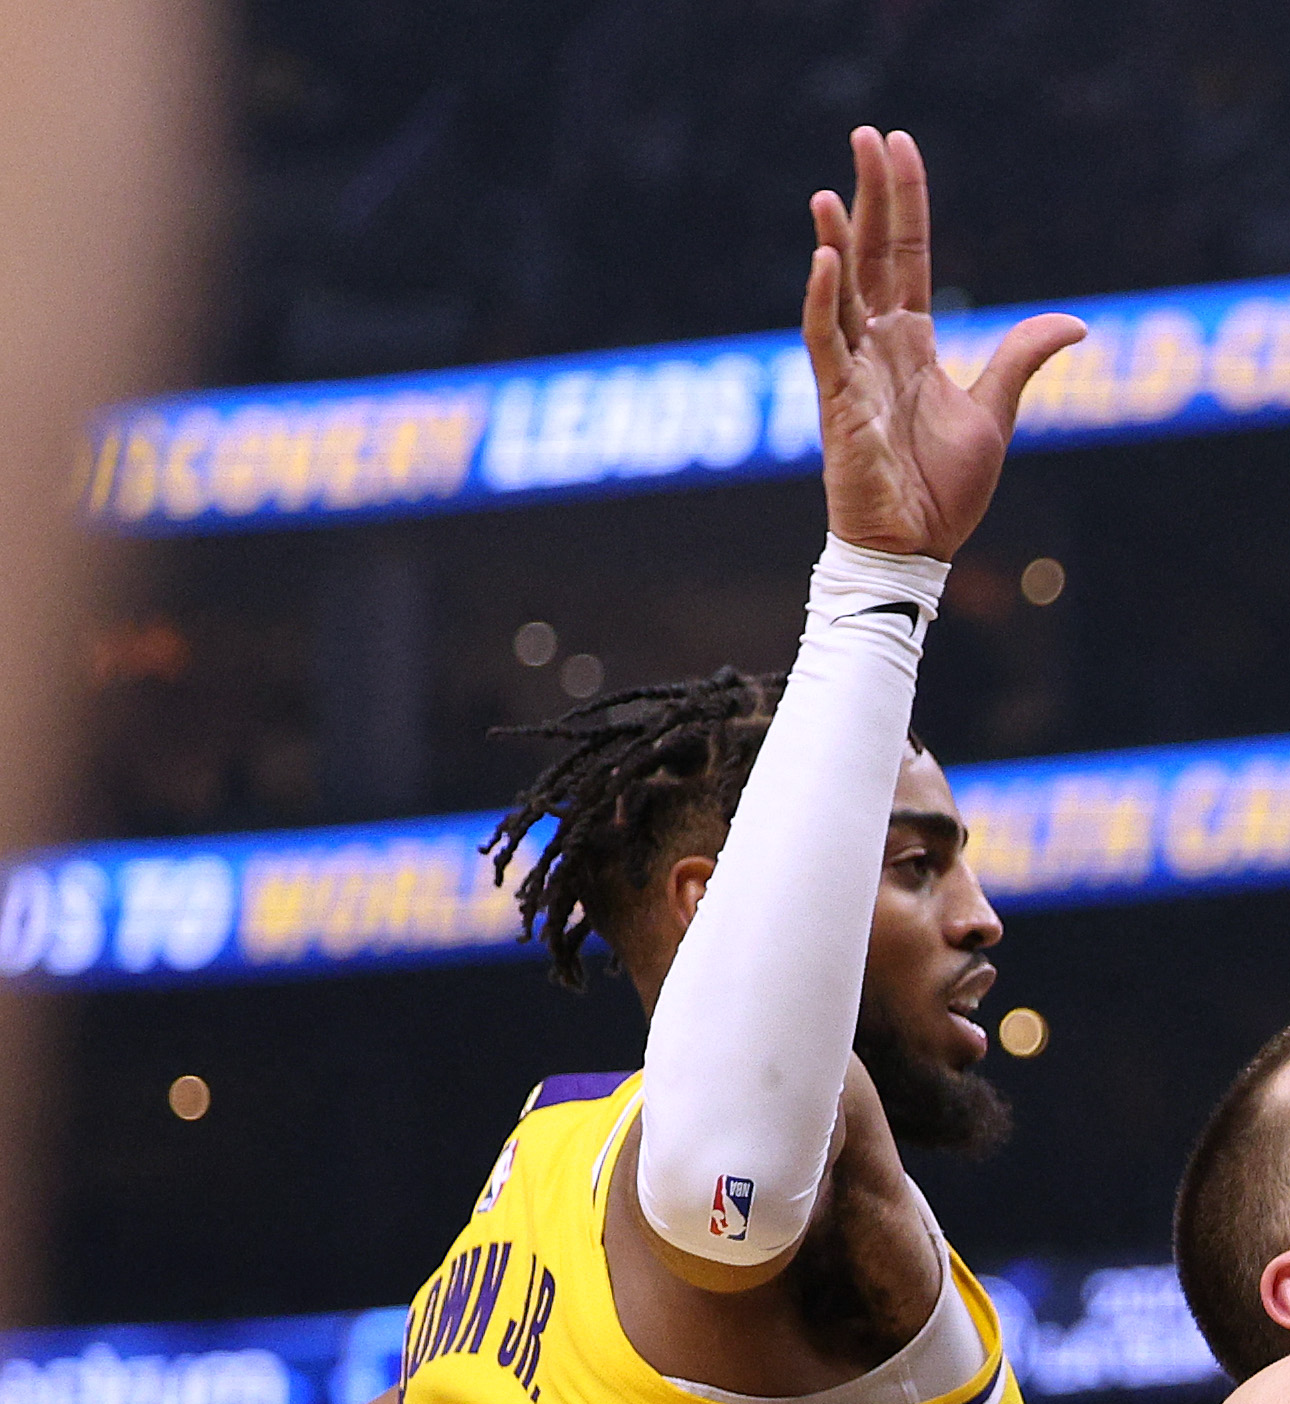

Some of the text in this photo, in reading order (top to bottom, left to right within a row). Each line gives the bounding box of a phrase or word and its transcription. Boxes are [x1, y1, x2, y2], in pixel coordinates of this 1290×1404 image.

[74, 384, 488, 522] ISCOVERY
[482, 350, 770, 496] LEADS
[953, 766, 1162, 896] ALTH
[113, 856, 233, 975] TO
[729, 1180, 751, 1198] NBA
[400, 1241, 556, 1404] OWN JR.
